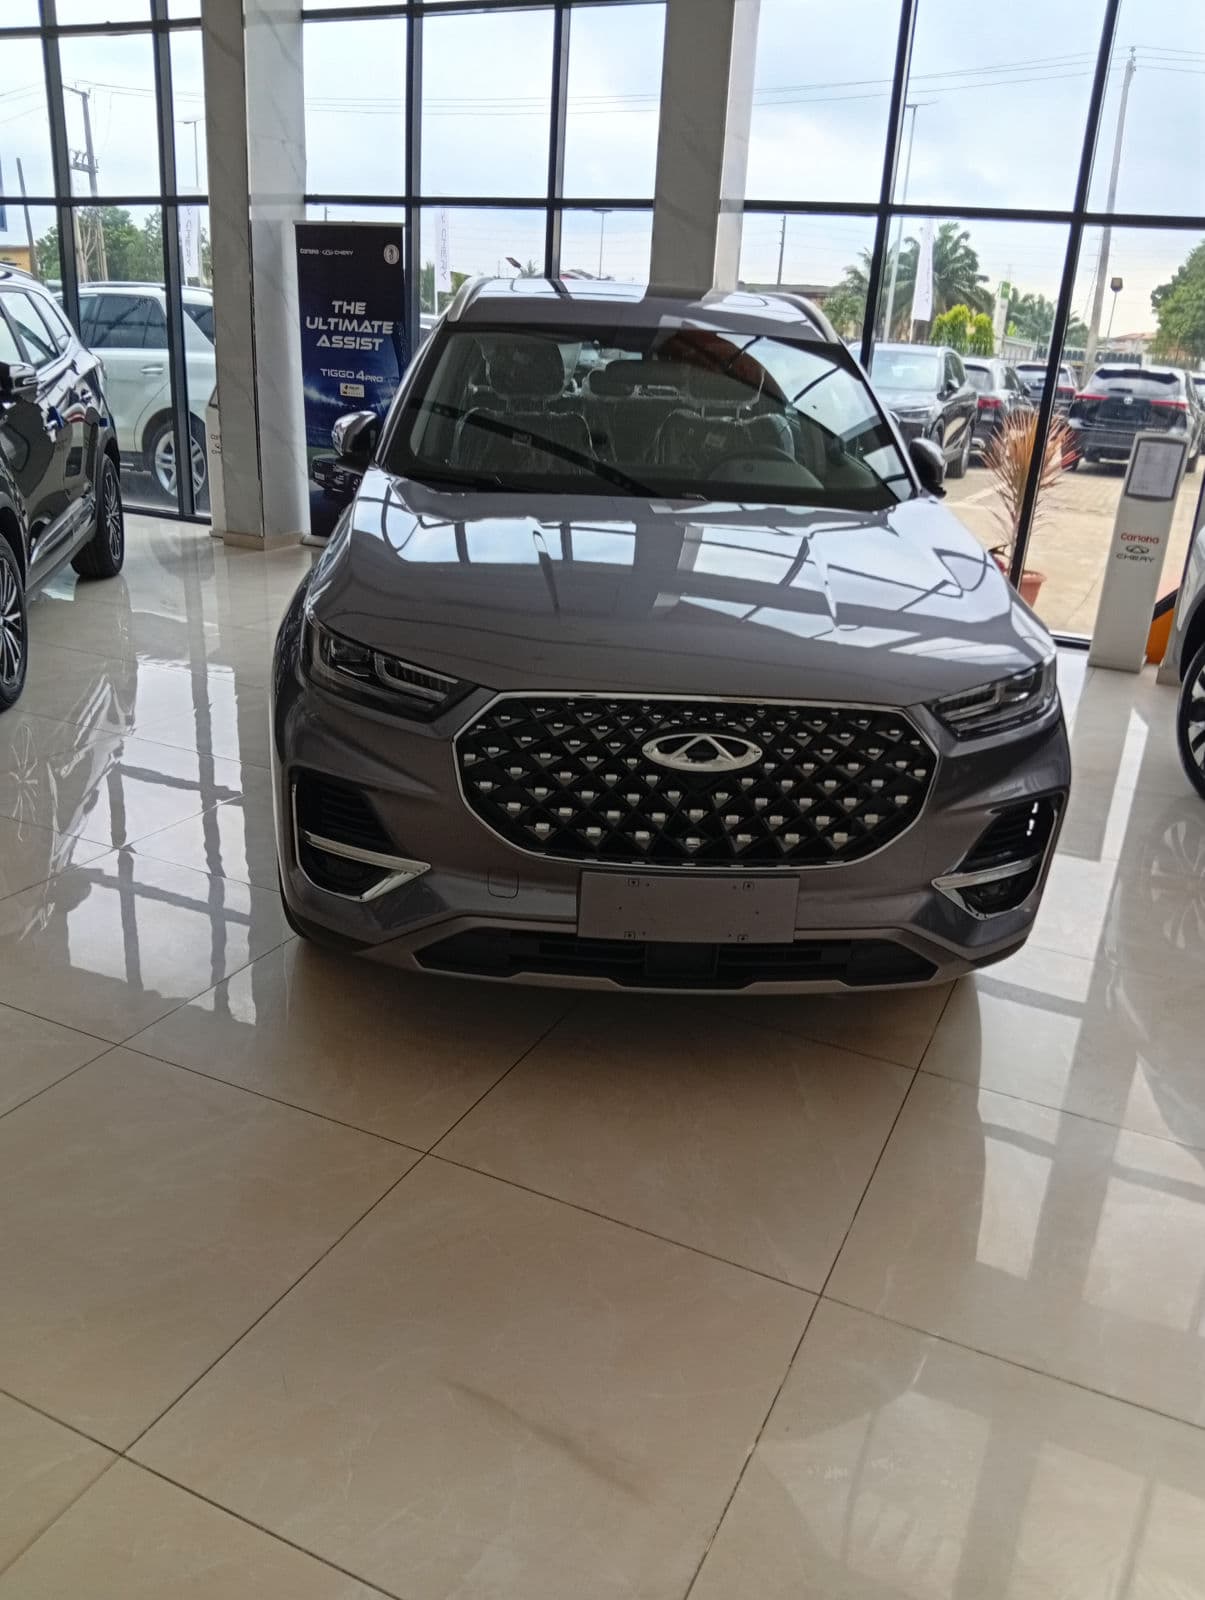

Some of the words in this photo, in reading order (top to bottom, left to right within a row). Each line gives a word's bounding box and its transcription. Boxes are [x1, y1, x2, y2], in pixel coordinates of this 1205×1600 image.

[331, 300, 367, 315] THE
[306, 315, 394, 335] ULTIMATE
[316, 334, 385, 351] ASSIST
[320, 368, 355, 379] TIGGO
